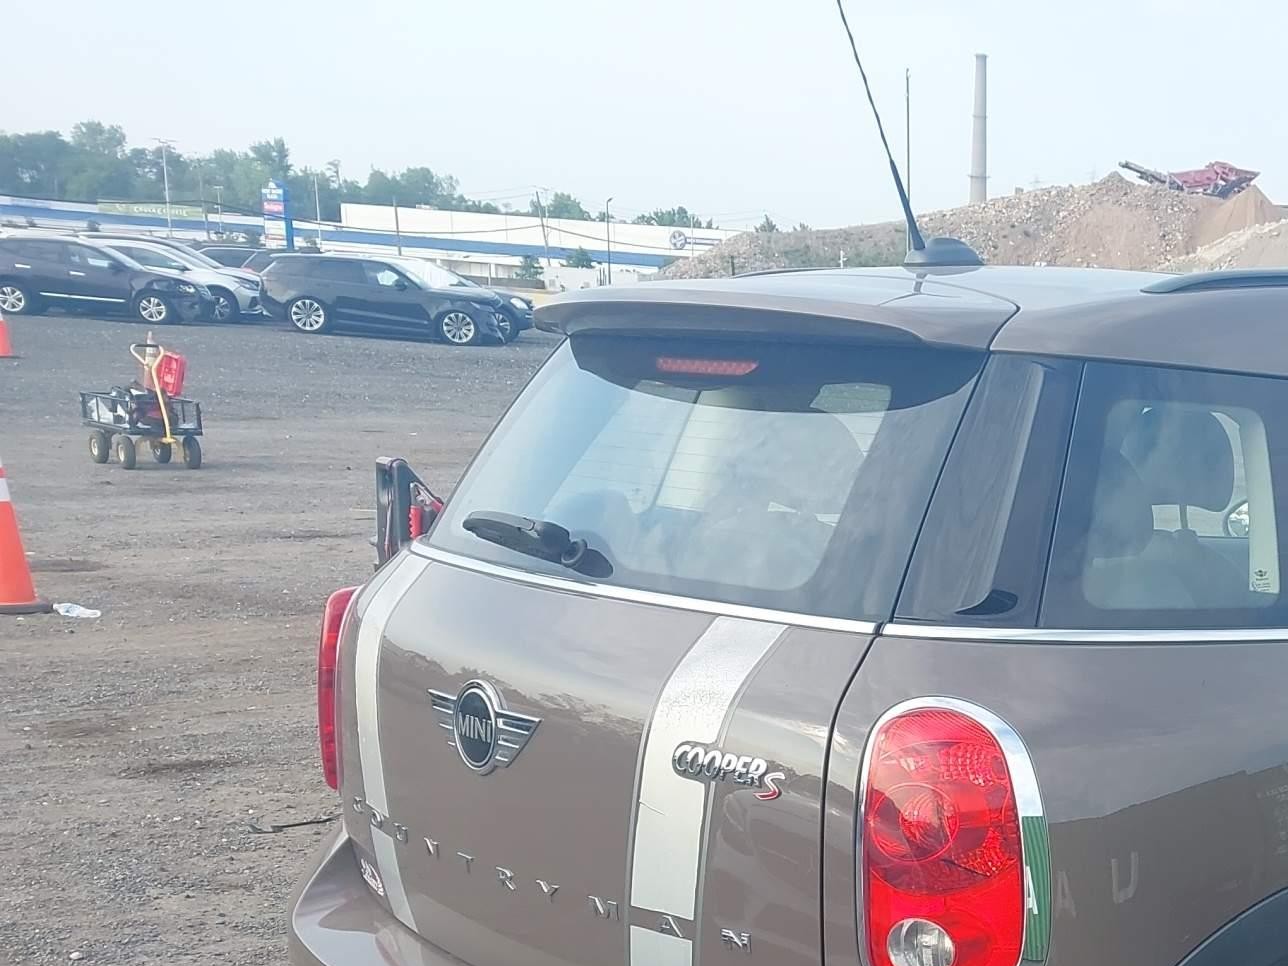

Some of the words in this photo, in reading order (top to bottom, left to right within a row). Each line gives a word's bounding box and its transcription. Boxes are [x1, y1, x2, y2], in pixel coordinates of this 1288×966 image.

[457, 711, 492, 744] MINI
[674, 744, 768, 786] COOPER
[752, 772, 786, 800] S
